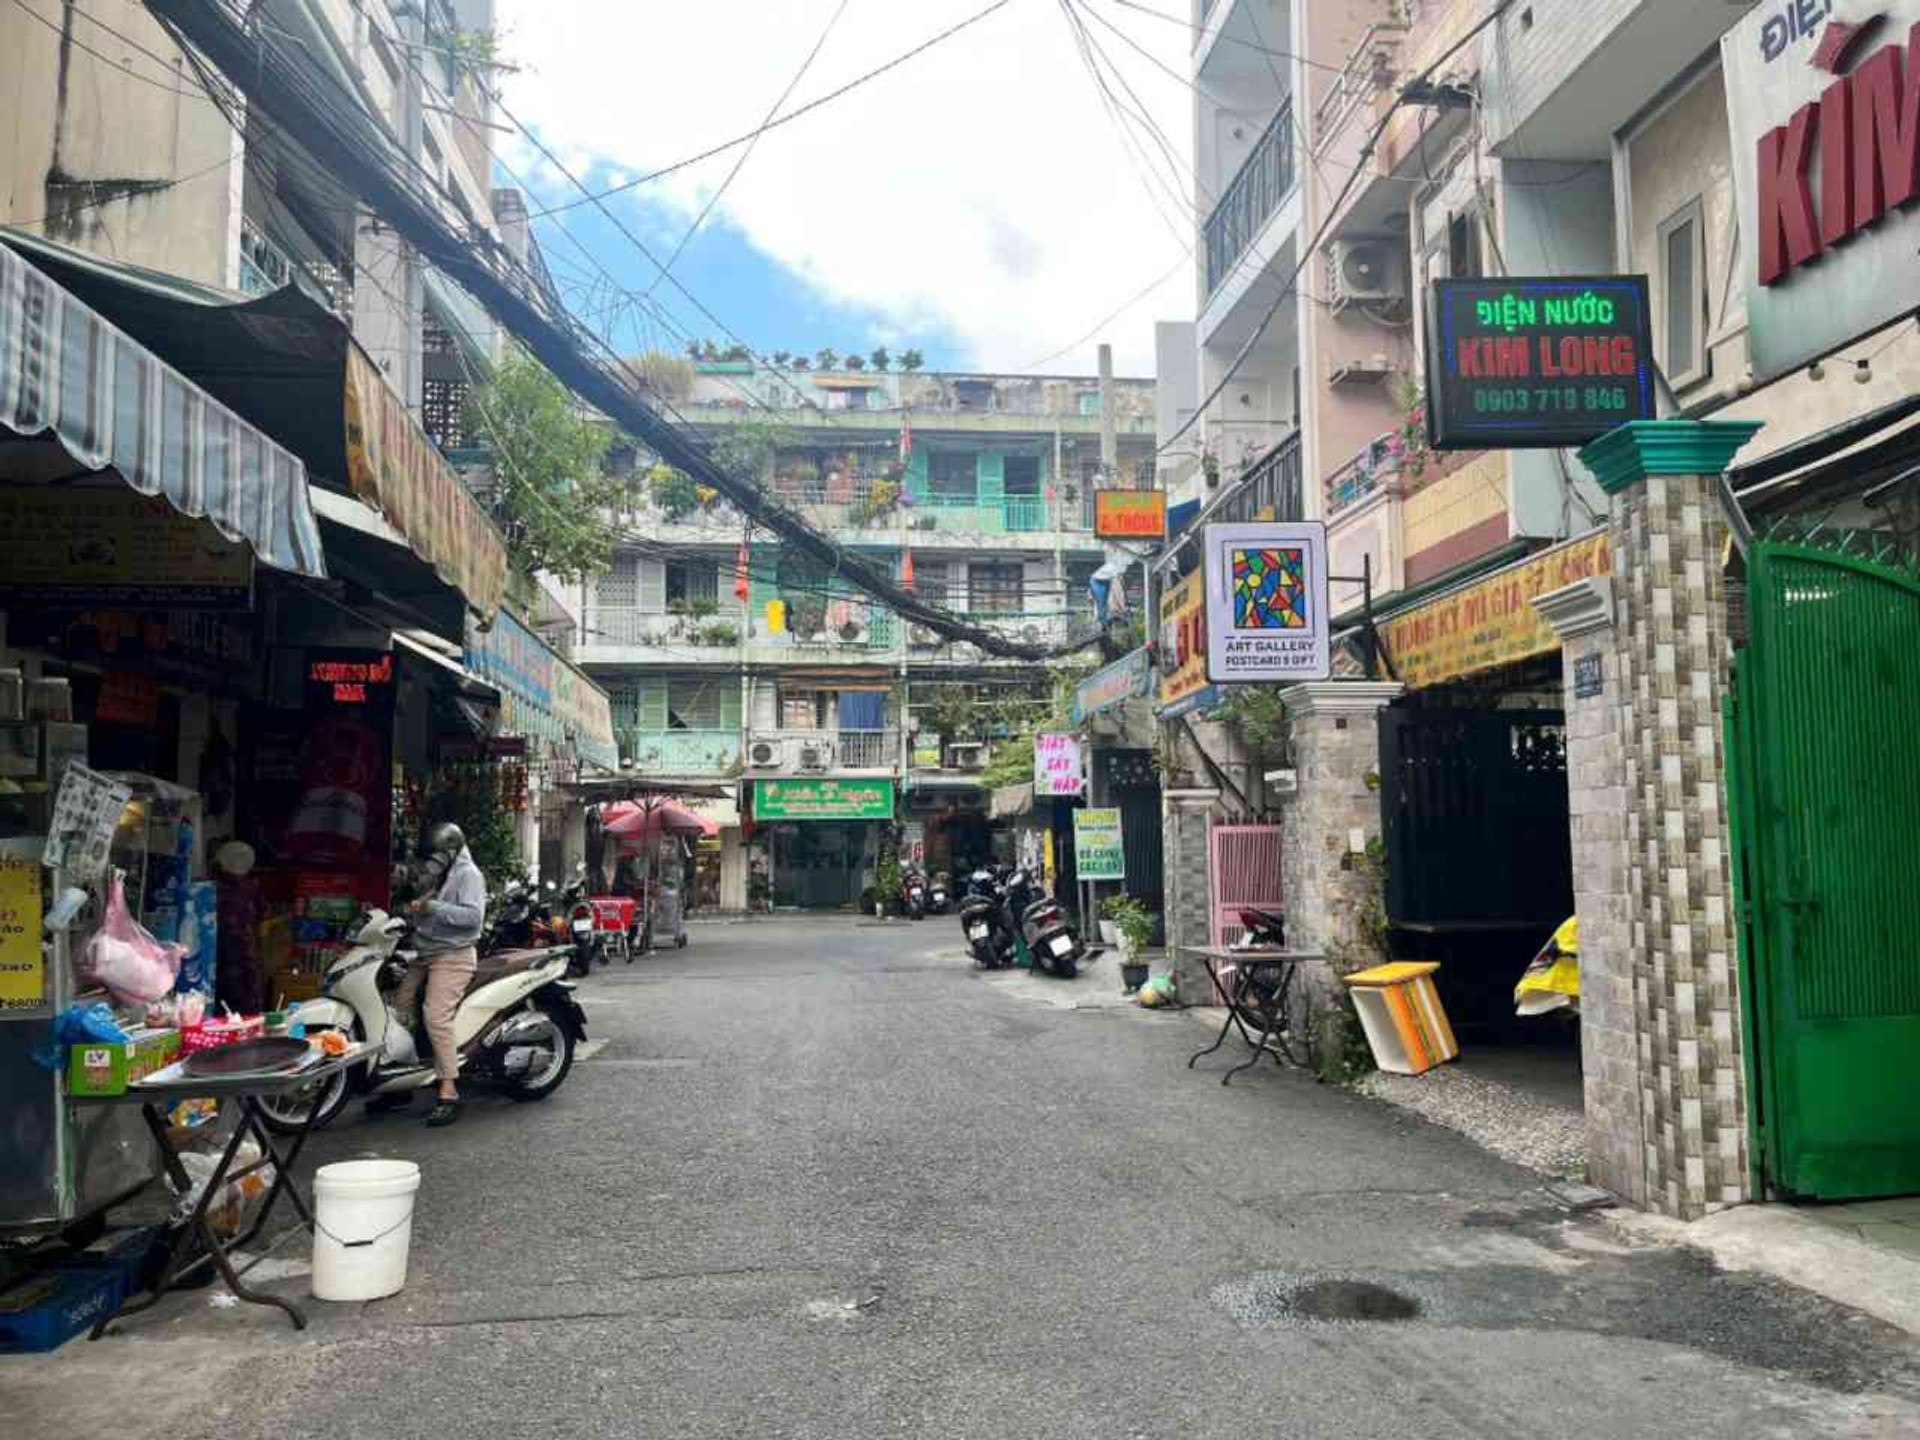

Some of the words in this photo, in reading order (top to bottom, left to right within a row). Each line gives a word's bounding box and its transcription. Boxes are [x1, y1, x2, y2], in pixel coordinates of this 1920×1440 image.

[1477, 292, 1536, 331] ĐIỆN
[1544, 291, 1615, 326] NƯỚC
[1458, 335, 1530, 378] KIM
[1539, 335, 1634, 377] LONG
[1475, 388, 1530, 412] 0903
[1226, 641, 1252, 652] ART
[1255, 640, 1315, 652] GALLERY
[1225, 655, 1281, 666] POSTCARD
[1292, 654, 1316, 665] GIFT
